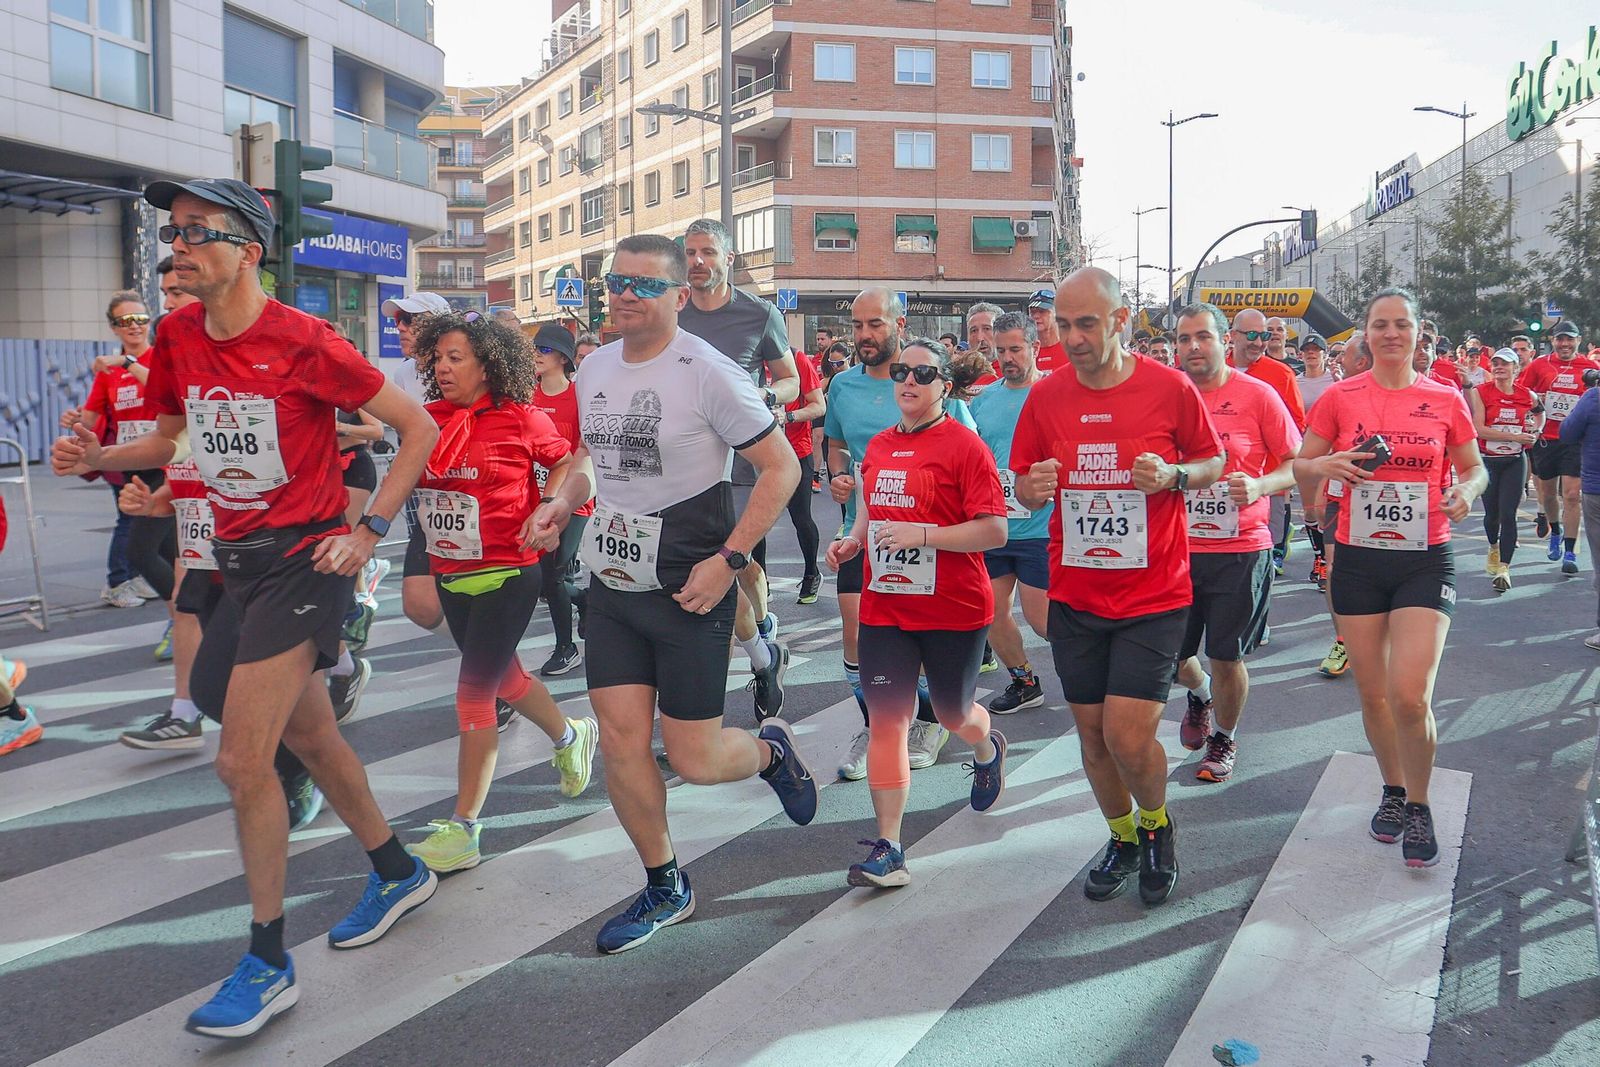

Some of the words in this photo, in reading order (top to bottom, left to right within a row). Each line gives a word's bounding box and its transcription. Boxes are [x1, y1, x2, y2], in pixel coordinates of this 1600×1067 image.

[1208, 292, 1300, 306] MARCELINO
[1552, 401, 1569, 411] 833
[202, 431, 259, 455] 3048
[584, 434, 611, 445] PRUEBA
[613, 435, 624, 445] DE
[624, 436, 655, 448] FONDO
[1077, 442, 1117, 454] MEMORIAL
[1077, 453, 1118, 470] PADRE
[877, 469, 907, 479] MEMORIAL
[1069, 469, 1131, 485] MARCELINO
[875, 478, 906, 494] PADRE
[870, 492, 915, 508] MARCELINO
[1185, 500, 1226, 515] 1456
[1363, 503, 1413, 522] 1463
[426, 512, 465, 531] 1005
[1076, 517, 1129, 537] 1743
[595, 533, 641, 563] 1989
[607, 557, 627, 568] CARLOS
